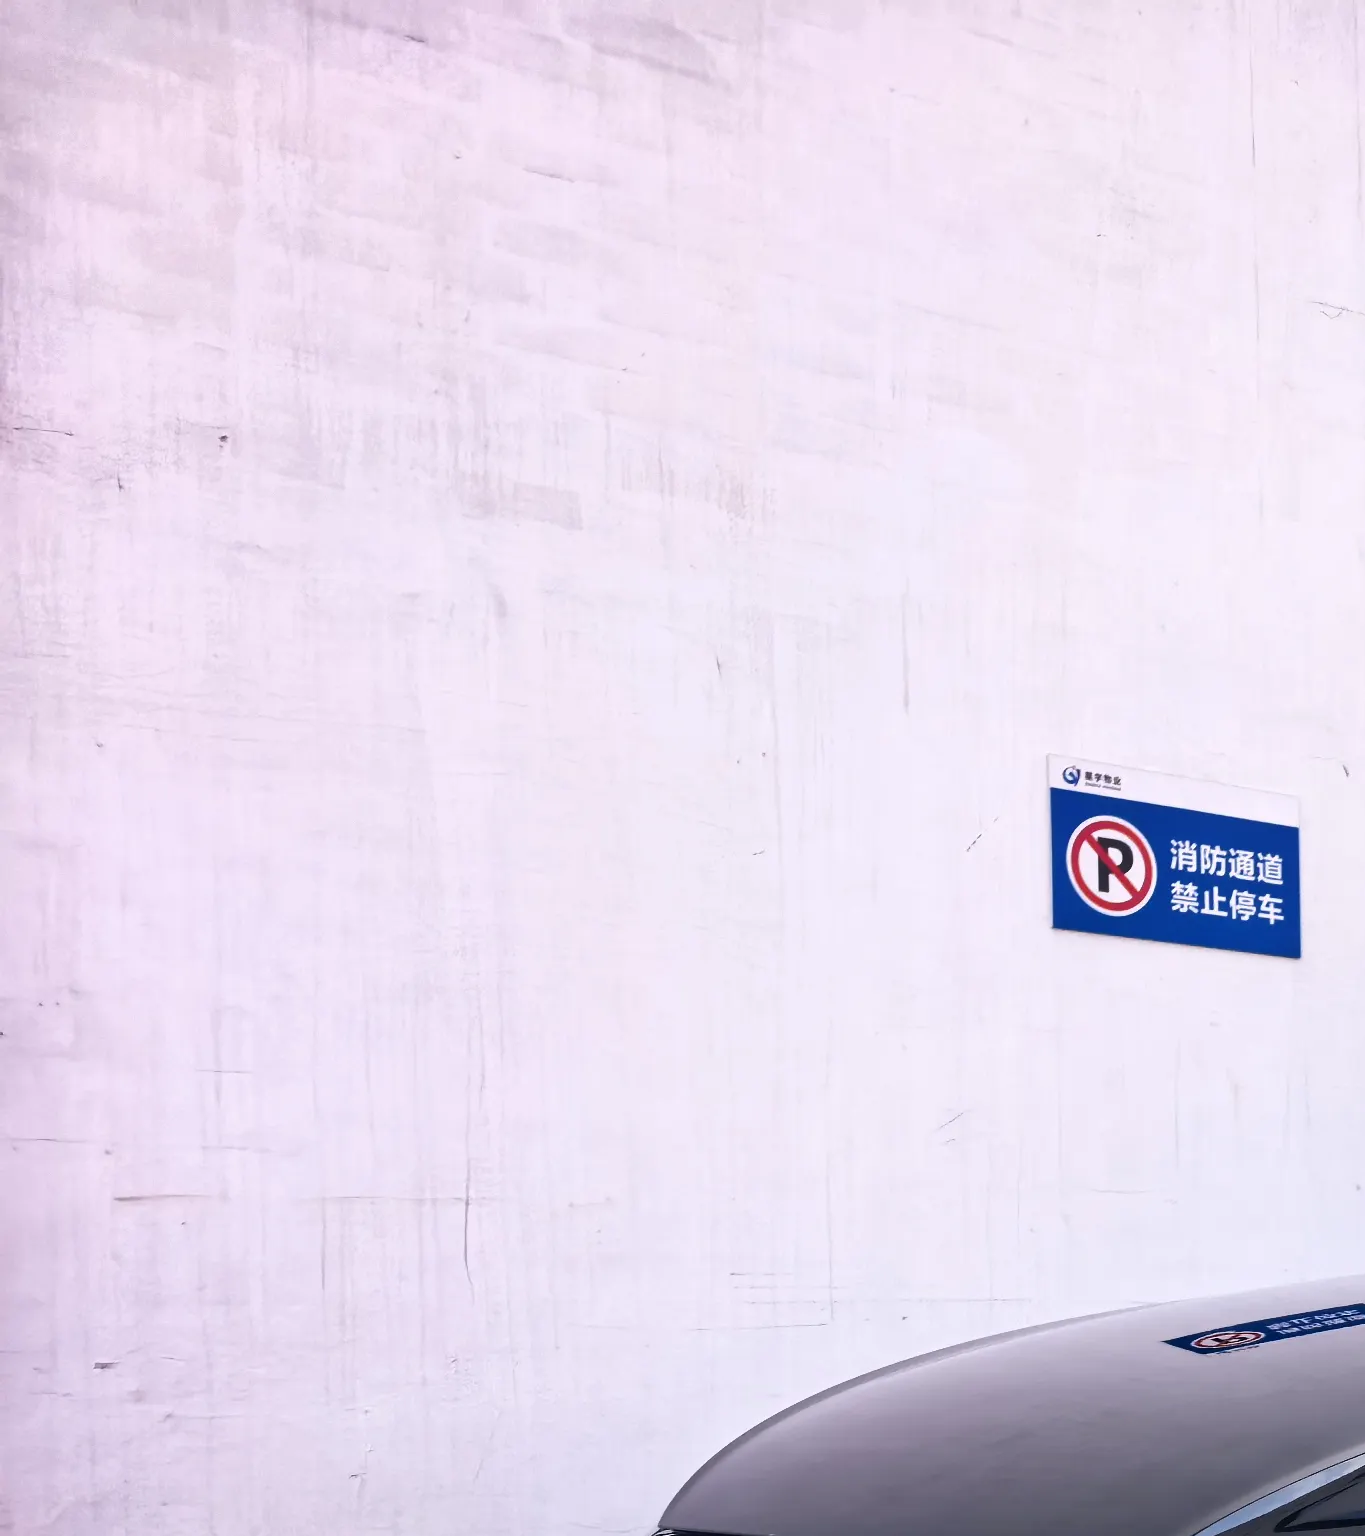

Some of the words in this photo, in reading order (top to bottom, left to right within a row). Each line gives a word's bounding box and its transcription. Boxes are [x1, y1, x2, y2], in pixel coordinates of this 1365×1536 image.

[1170, 839, 1284, 885] 消防通道
[1171, 881, 1285, 925] 禁止停车
